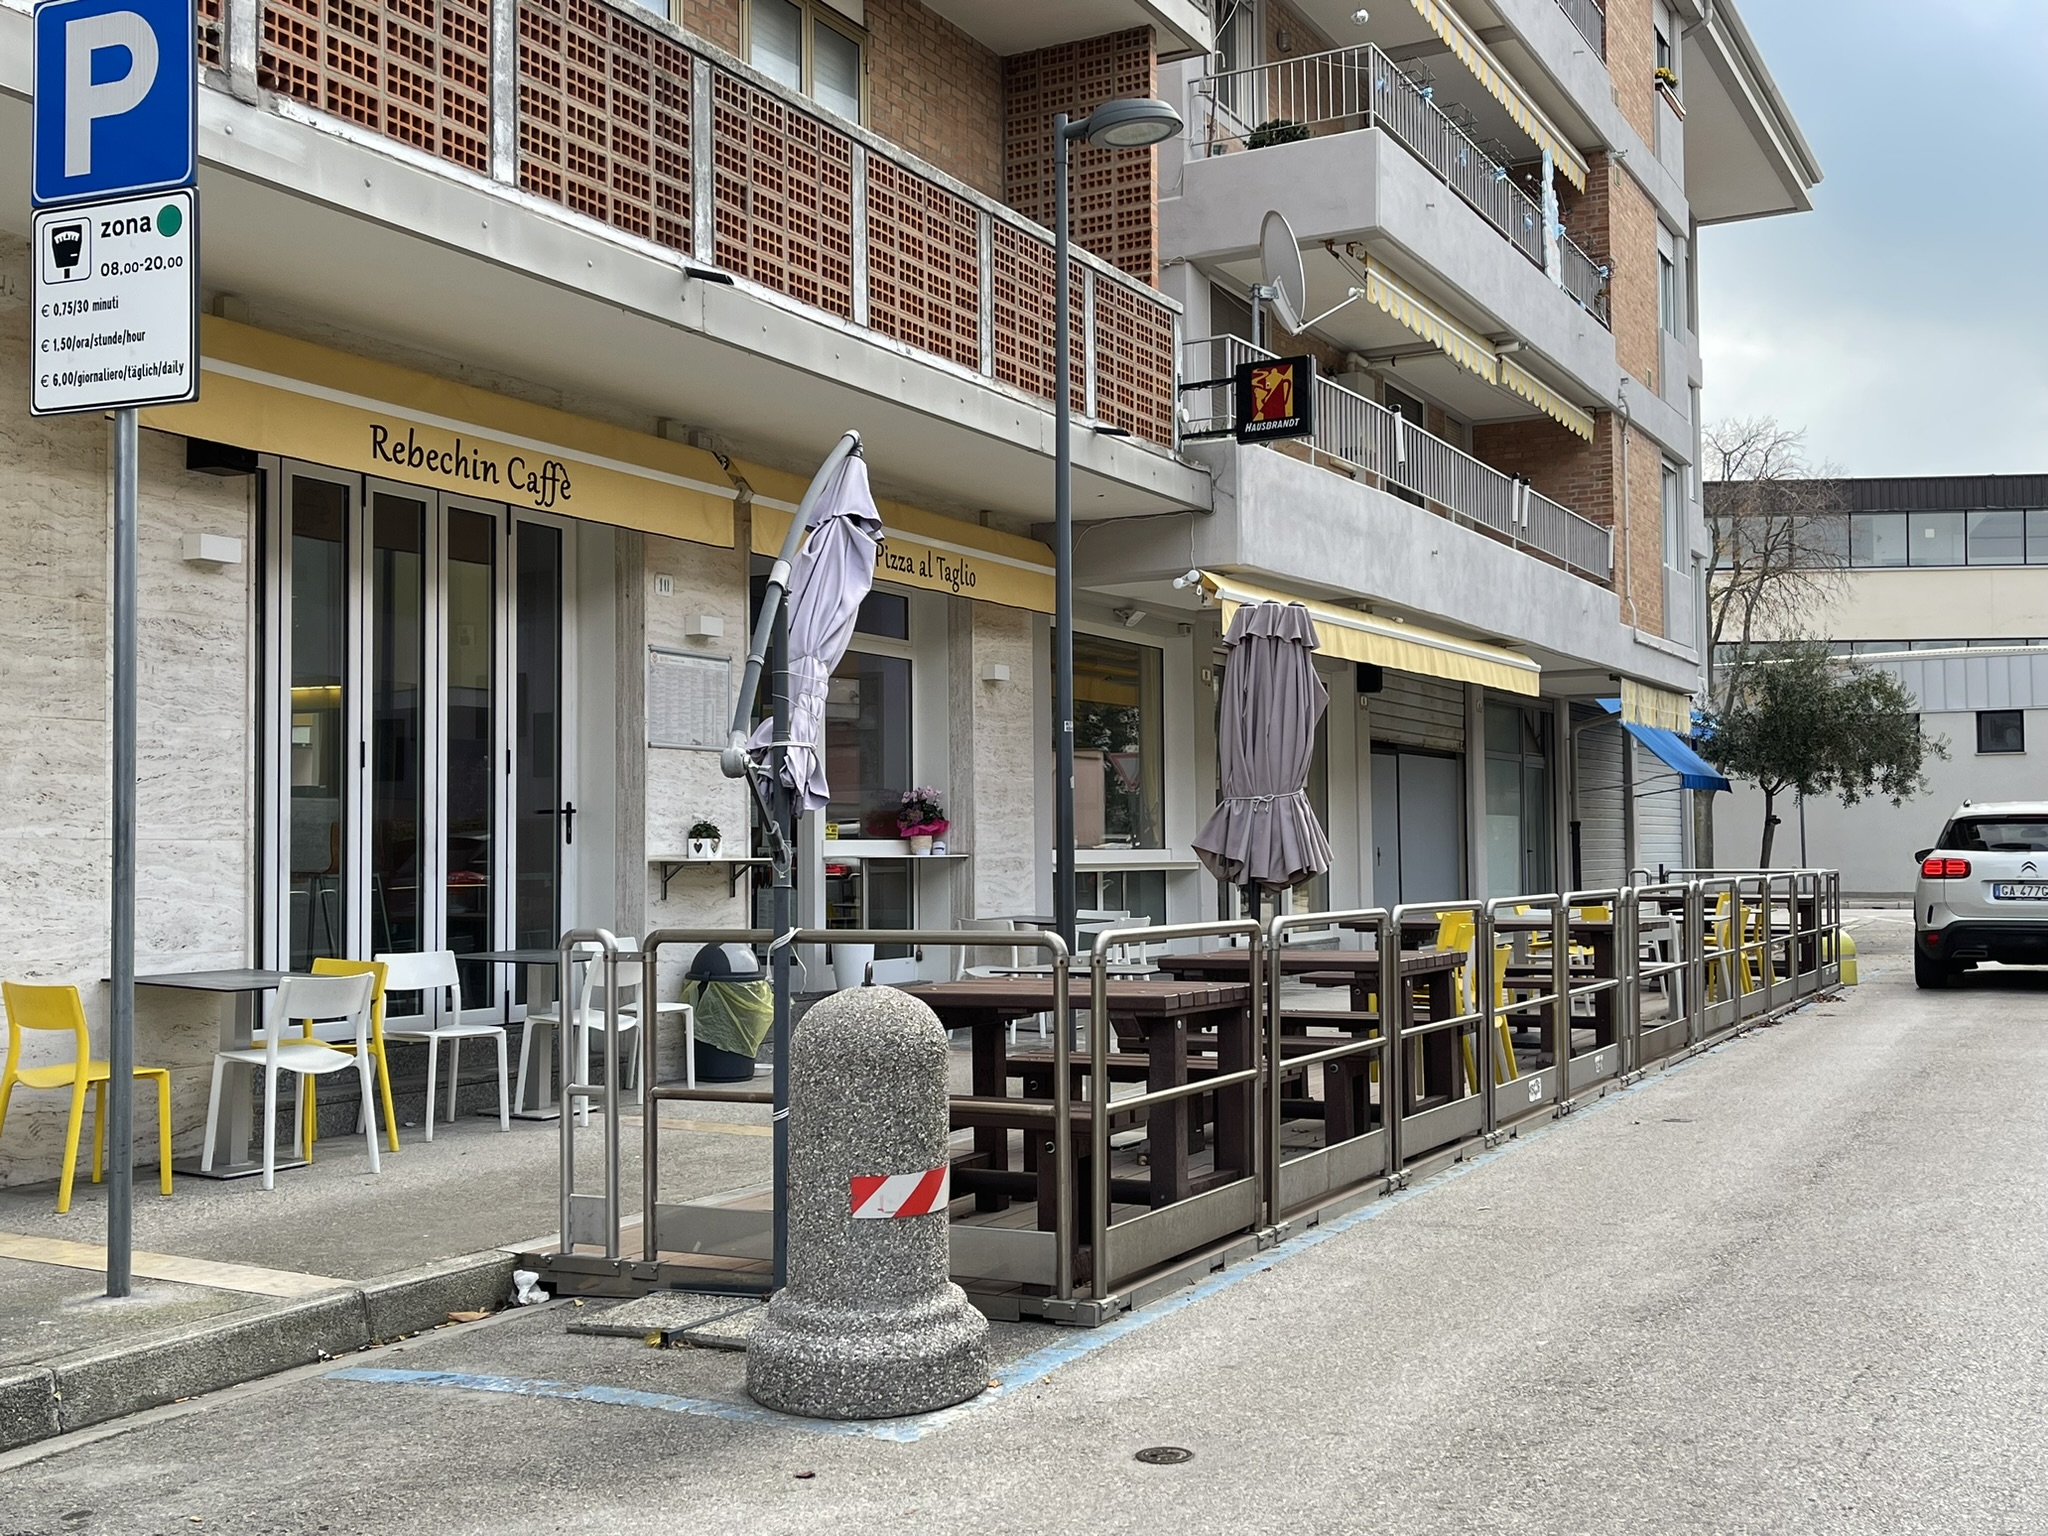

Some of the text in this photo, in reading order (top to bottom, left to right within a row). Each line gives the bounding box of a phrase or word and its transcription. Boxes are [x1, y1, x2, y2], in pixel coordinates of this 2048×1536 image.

[64, 10, 159, 178] P
[100, 215, 152, 238] zona
[41, 304, 50, 318] €
[92, 295, 119, 312] minuti
[41, 339, 50, 352] €
[41, 374, 50, 387] €
[1244, 418, 1300, 433] HAUSBRANDT
[369, 424, 572, 508] Rebechin Caffè
[876, 542, 976, 593] Pizza al Taglio
[659, 577, 670, 593] 10
